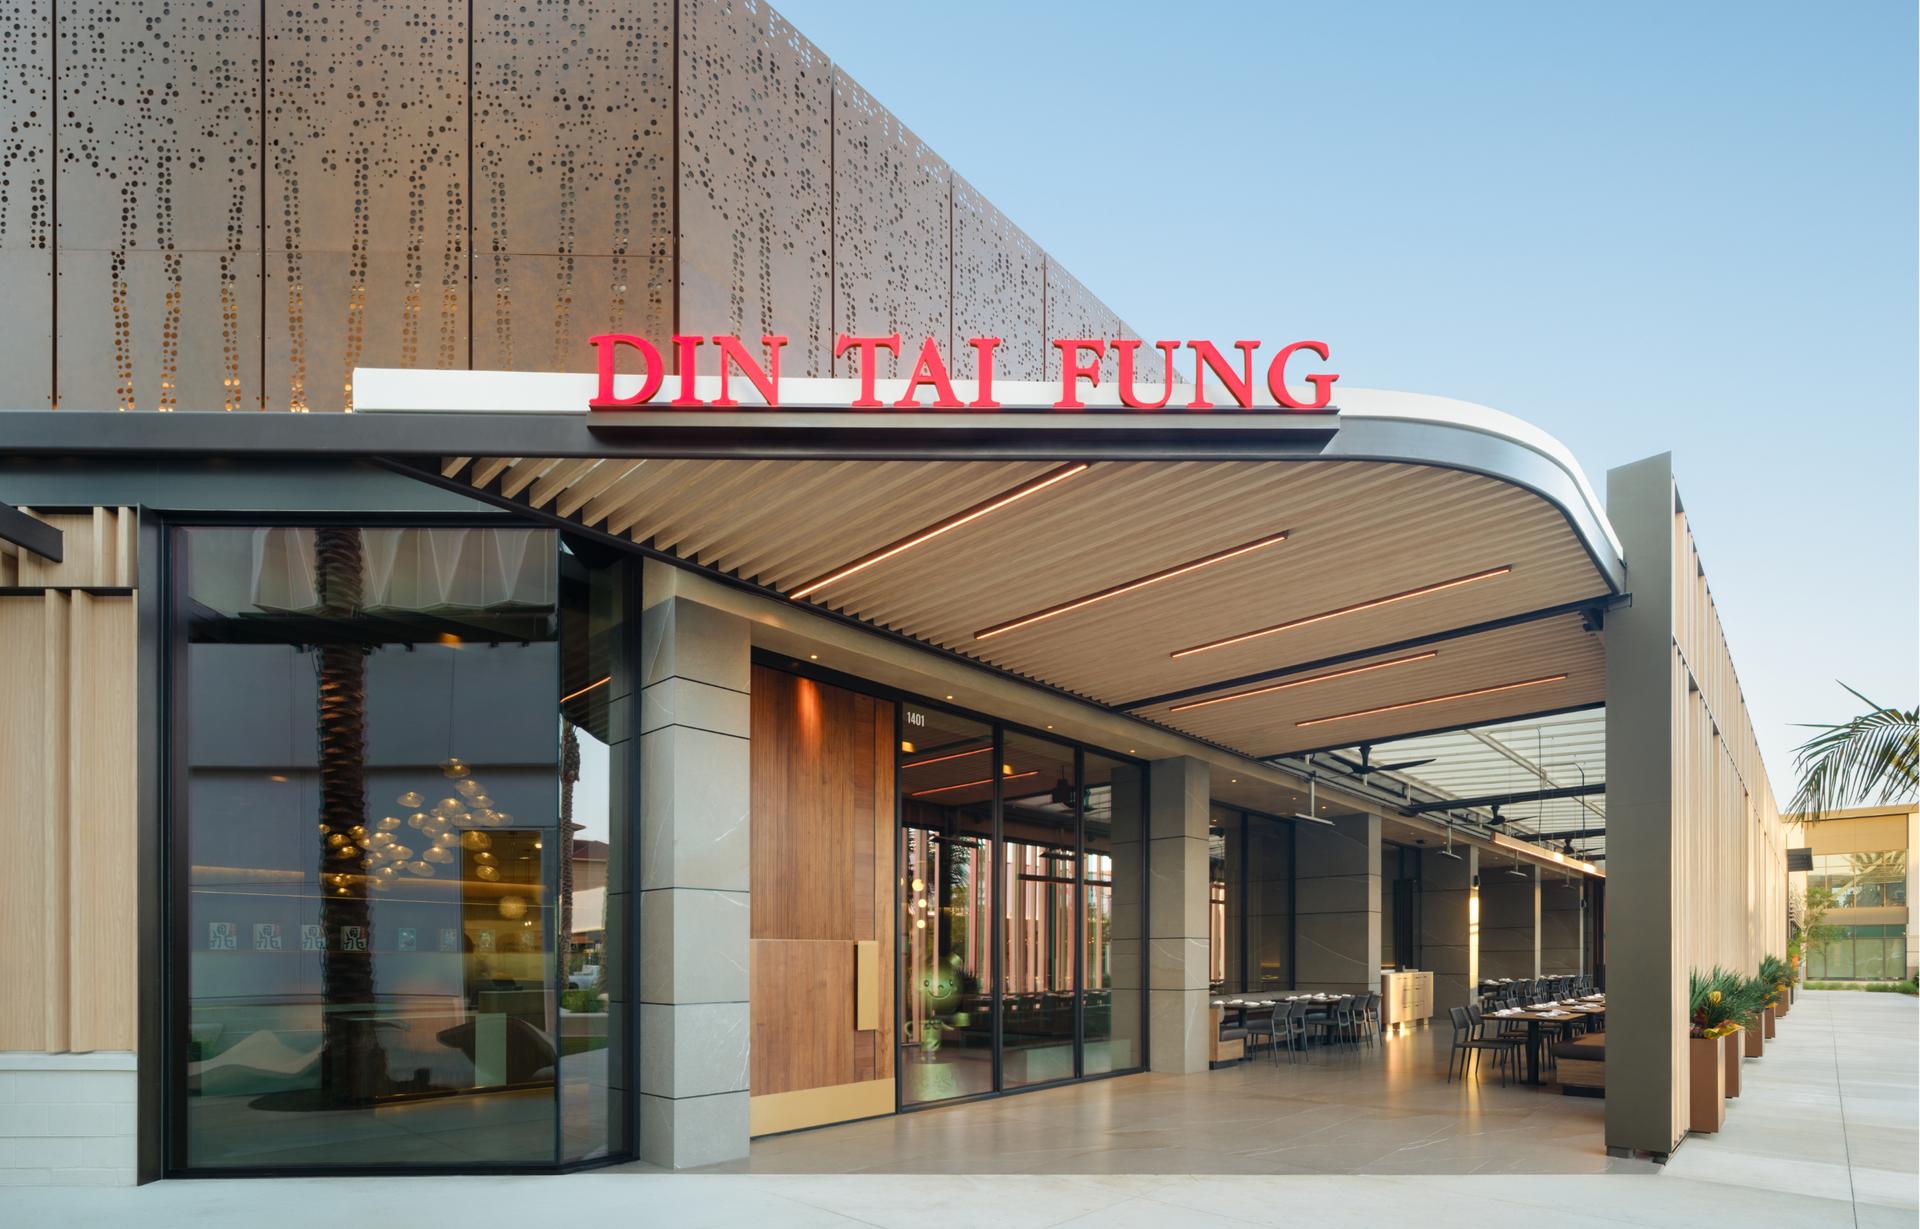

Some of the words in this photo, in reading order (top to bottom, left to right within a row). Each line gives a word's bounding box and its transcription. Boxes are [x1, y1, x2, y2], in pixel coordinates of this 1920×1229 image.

[588, 333, 788, 408] DIN
[834, 333, 1002, 409] TAI
[1053, 339, 1340, 411] FUNG
[906, 711, 925, 727] 1401
